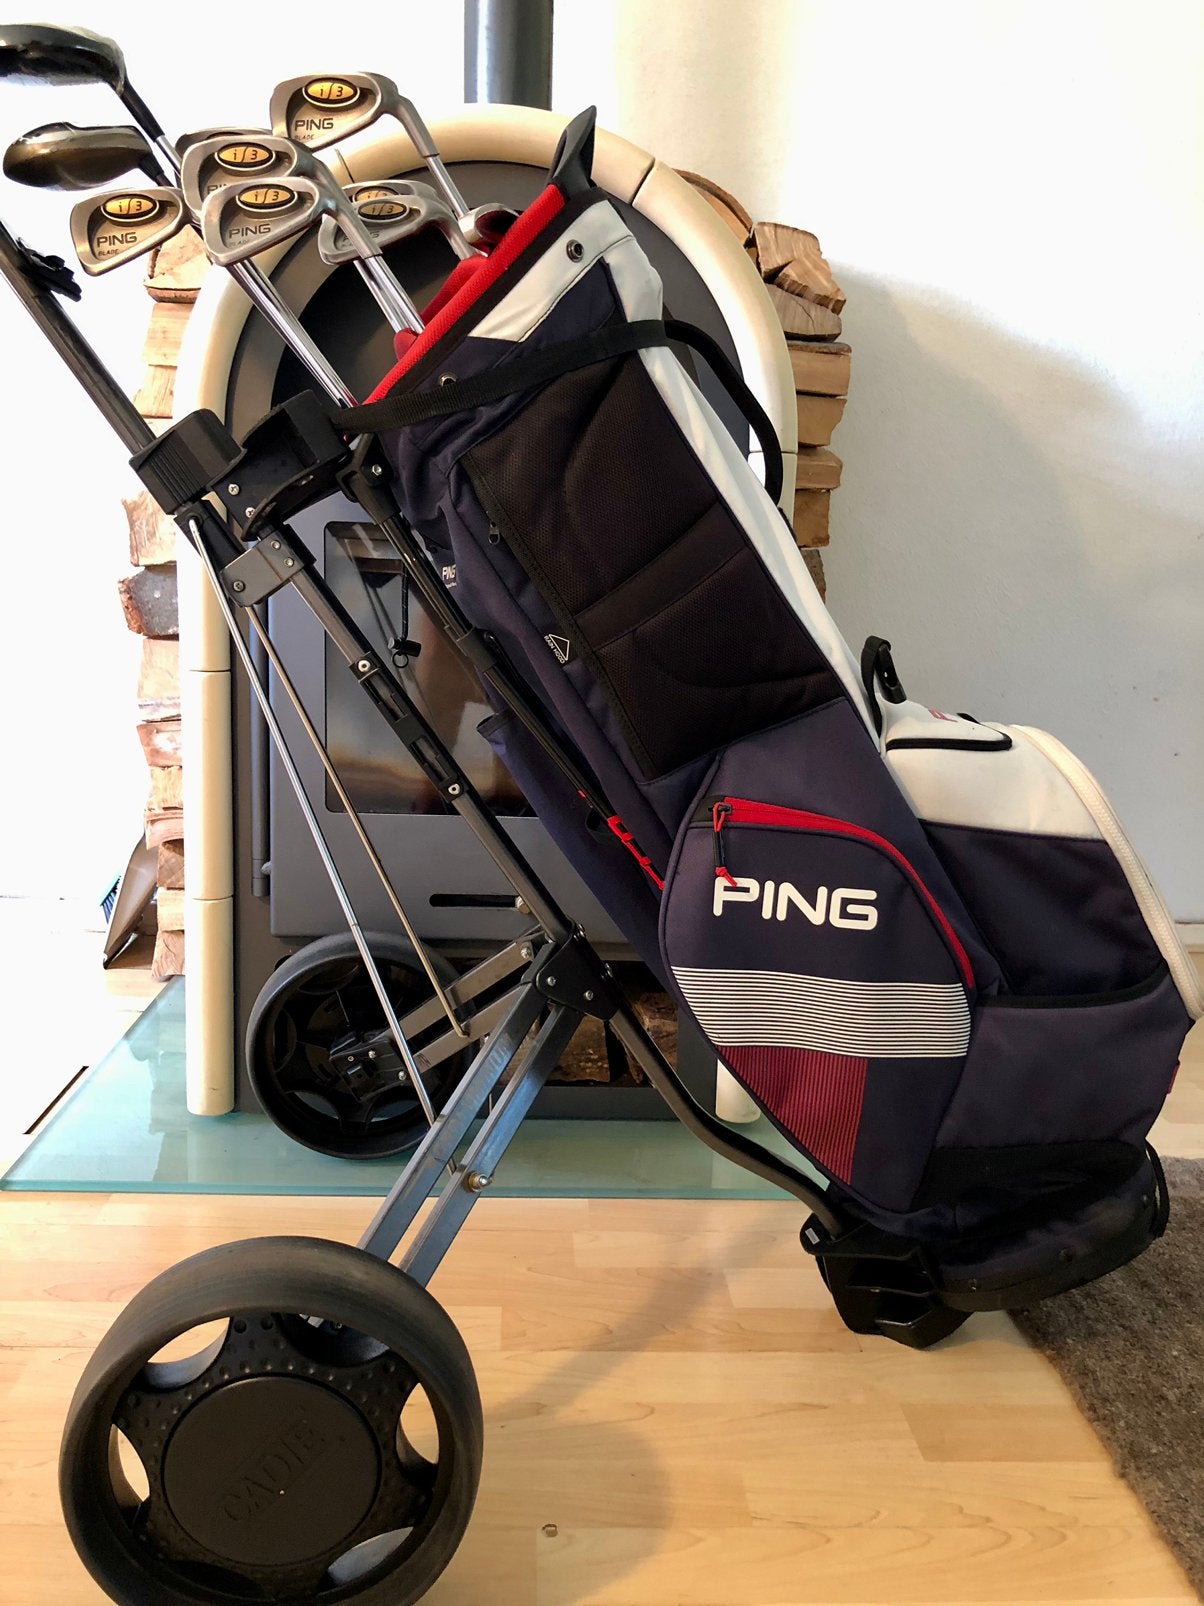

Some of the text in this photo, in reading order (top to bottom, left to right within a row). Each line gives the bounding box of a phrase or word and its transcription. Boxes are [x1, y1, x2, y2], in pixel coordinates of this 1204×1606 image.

[294, 118, 334, 131] PING
[229, 223, 271, 239] PING
[97, 232, 137, 247] PING
[553, 648, 565, 664] HOOD
[713, 876, 878, 931] PING
